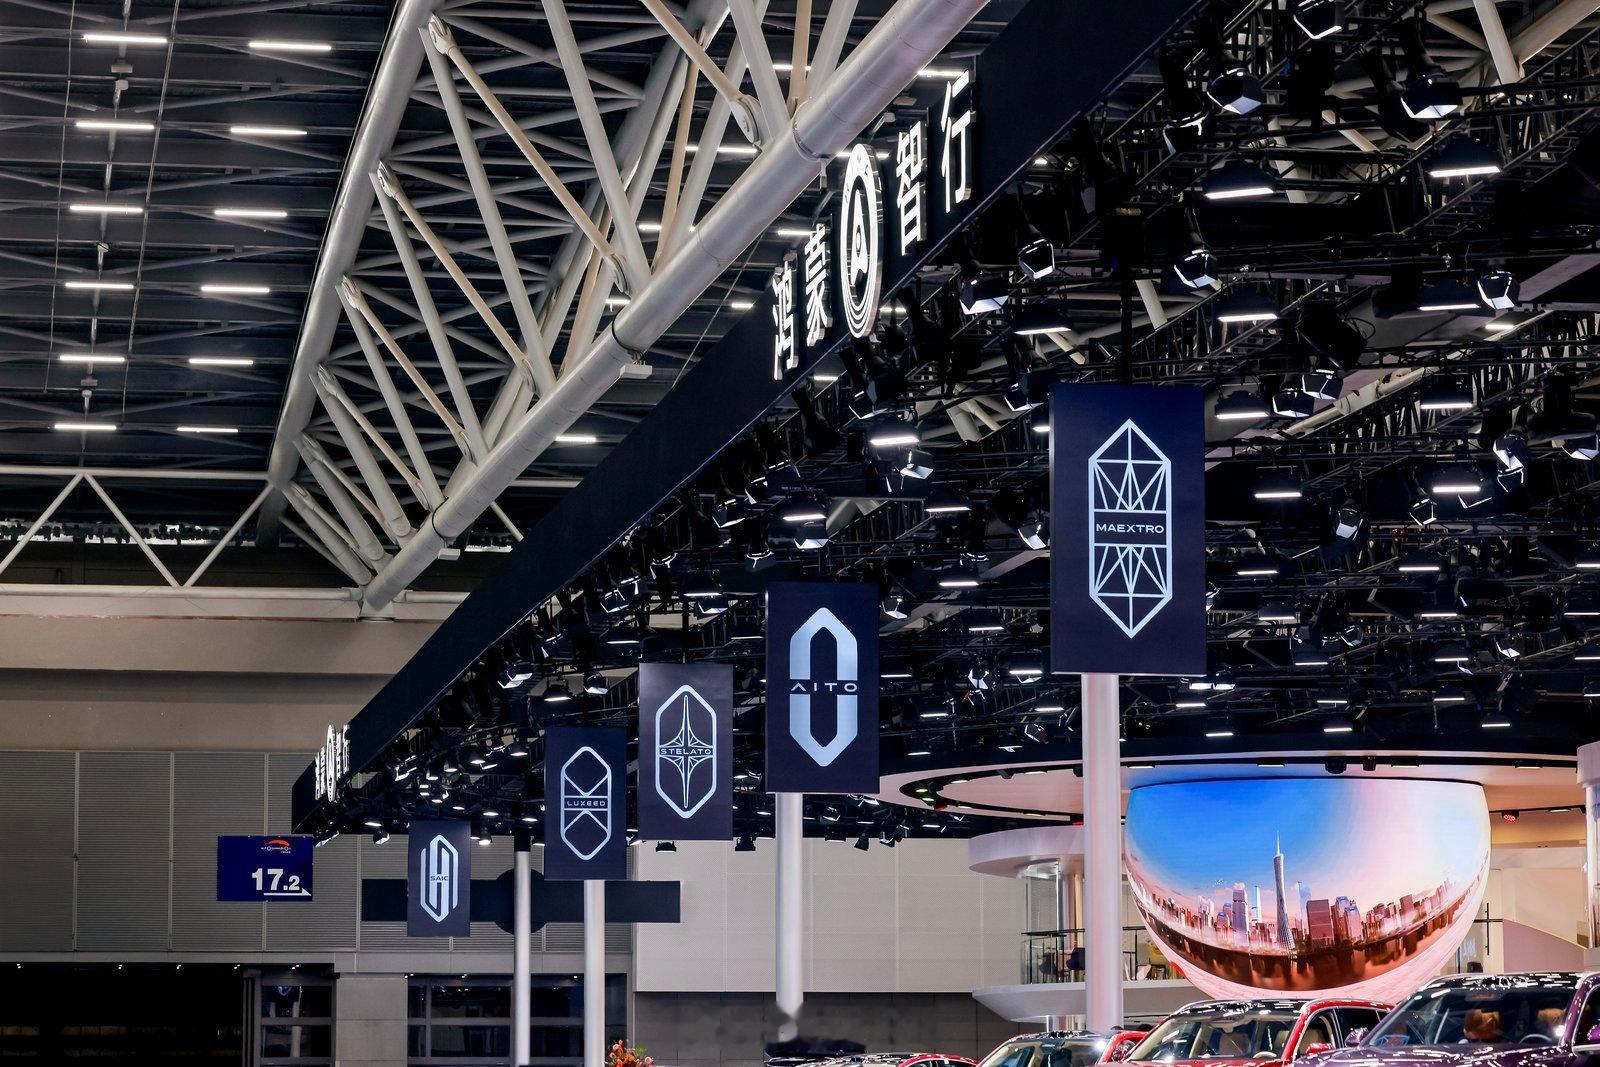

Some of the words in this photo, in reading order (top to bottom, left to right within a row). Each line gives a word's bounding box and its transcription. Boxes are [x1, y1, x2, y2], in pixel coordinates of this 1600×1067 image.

[1096, 523, 1165, 534] MAEXTRO
[790, 682, 858, 693] AITO
[251, 867, 301, 891] 17.2
